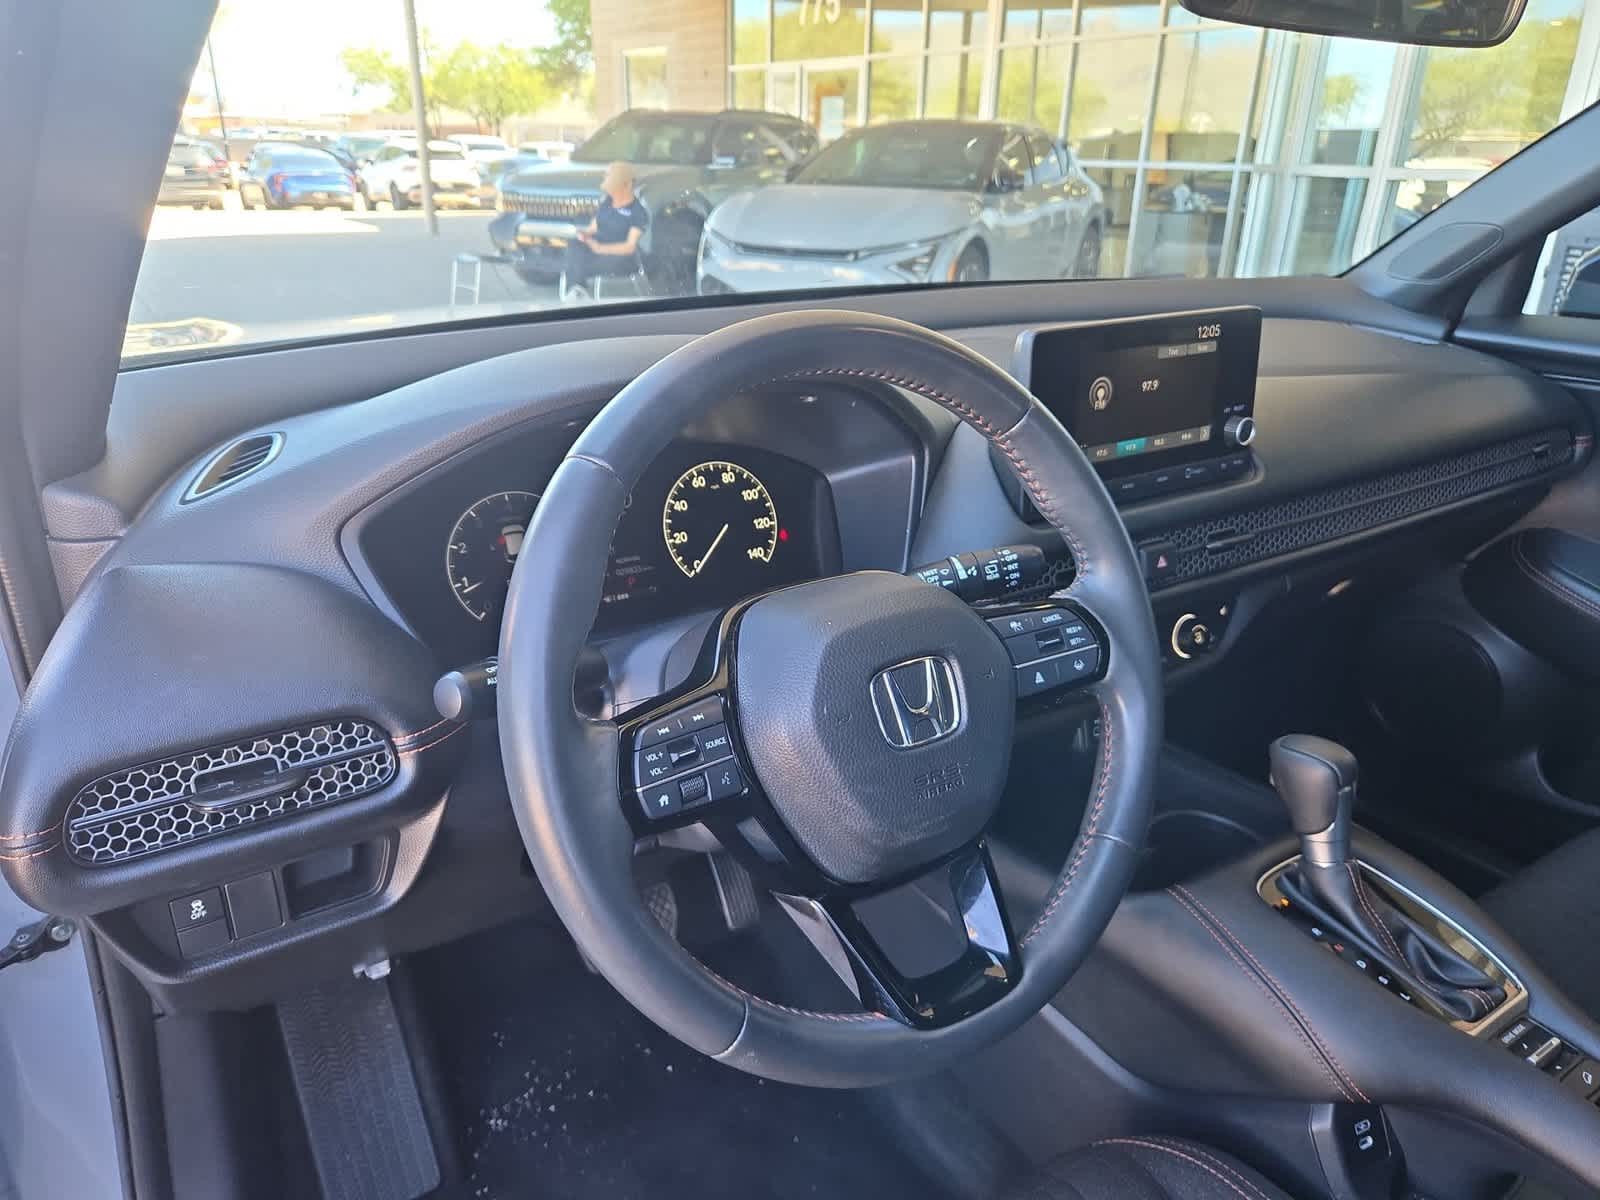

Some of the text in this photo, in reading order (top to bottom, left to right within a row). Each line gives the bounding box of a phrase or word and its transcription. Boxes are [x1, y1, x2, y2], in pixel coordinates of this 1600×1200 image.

[1198, 324, 1221, 338] 12:05
[691, 475, 706, 488] 60
[721, 471, 735, 484] 80
[741, 488, 759, 501] 100
[673, 499, 688, 512] 40
[753, 516, 770, 530] 120
[673, 531, 688, 544] 20
[458, 542, 467, 554] 2
[746, 546, 765, 560] 140
[1041, 613, 1063, 624] CANCEL
[705, 737, 727, 750] SOURCE
